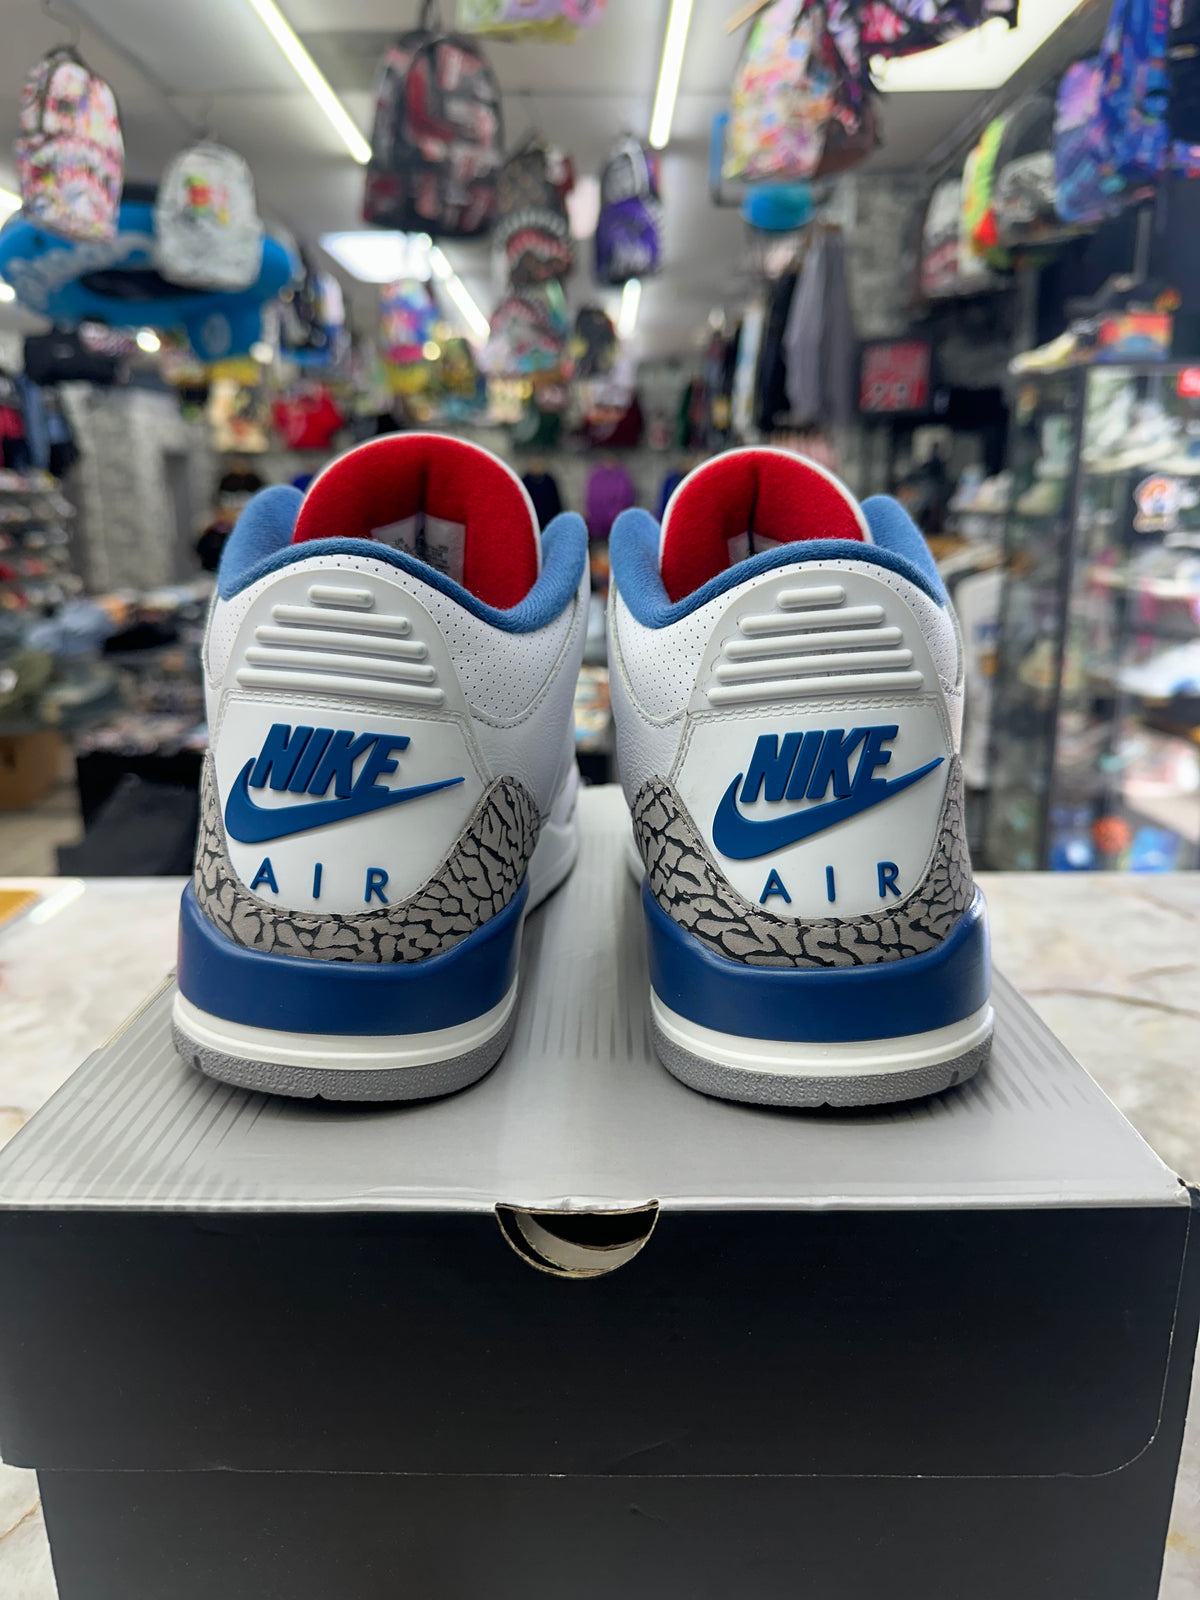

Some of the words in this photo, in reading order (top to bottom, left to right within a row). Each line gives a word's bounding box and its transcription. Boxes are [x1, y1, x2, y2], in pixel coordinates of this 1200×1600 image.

[249, 723, 411, 798] NIKE
[739, 725, 899, 803] NIKE
[250, 857, 389, 904] AIR
[759, 861, 902, 904] AIR
